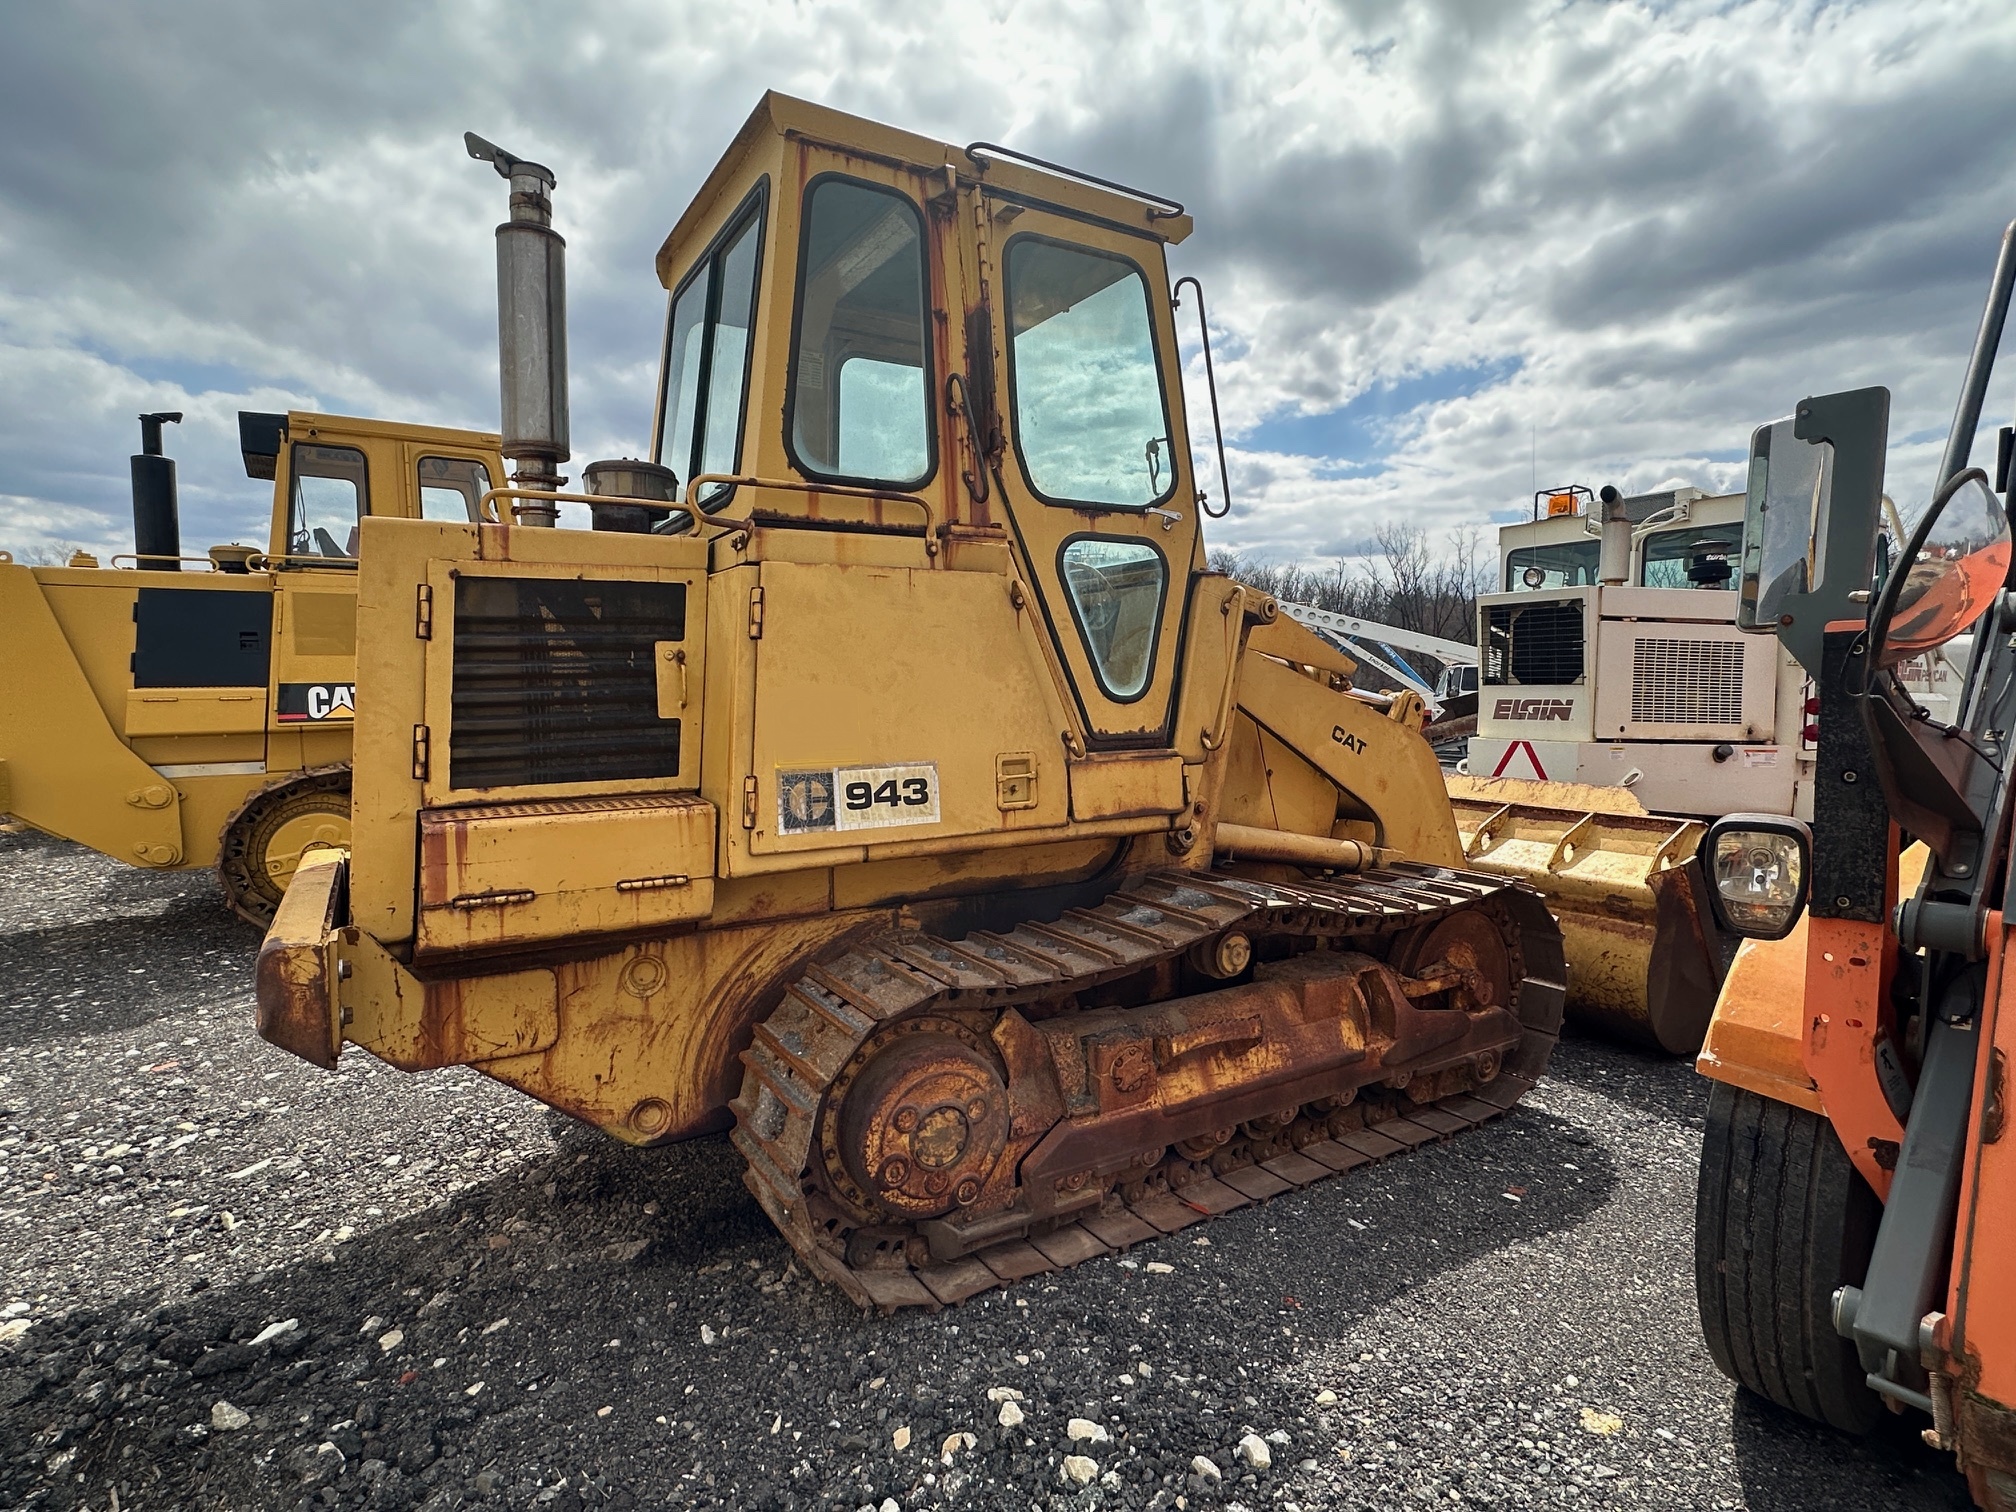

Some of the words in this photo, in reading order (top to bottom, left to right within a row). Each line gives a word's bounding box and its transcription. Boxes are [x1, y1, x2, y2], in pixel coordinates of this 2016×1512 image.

[308, 686, 355, 718] CA
[1493, 699, 1574, 721] ELGIN
[1332, 725, 1367, 755] CAT
[846, 778, 929, 810] 943
